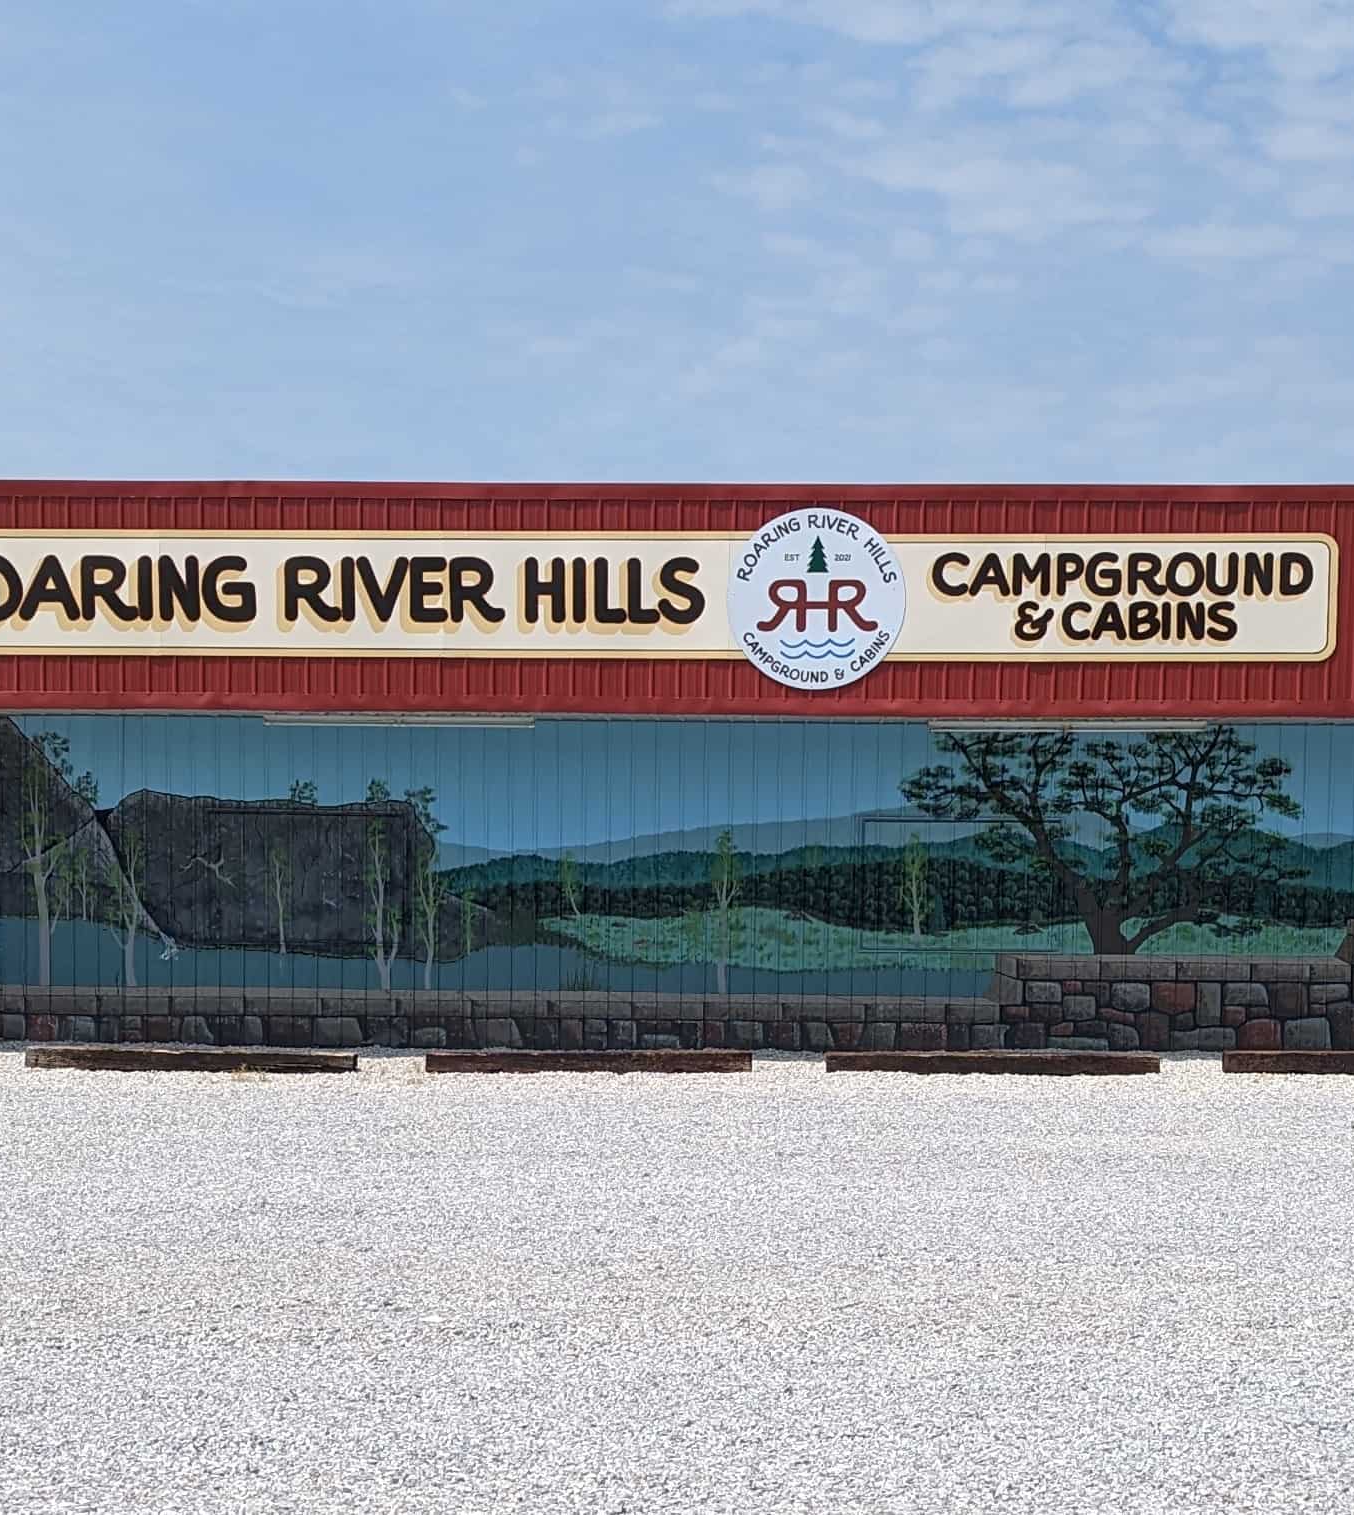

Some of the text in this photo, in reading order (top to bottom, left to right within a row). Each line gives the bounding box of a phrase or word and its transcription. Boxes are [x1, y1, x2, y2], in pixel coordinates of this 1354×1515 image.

[737, 514, 898, 584] ROARING RIVER HILLS
[784, 553, 800, 562] EST
[282, 555, 507, 625] RIVER
[522, 556, 707, 626] HILLS
[930, 551, 1315, 598] CAMPGROUND
[1013, 600, 1239, 642] & CABINS
[743, 630, 890, 683] CAMPGROUND & CABINS
